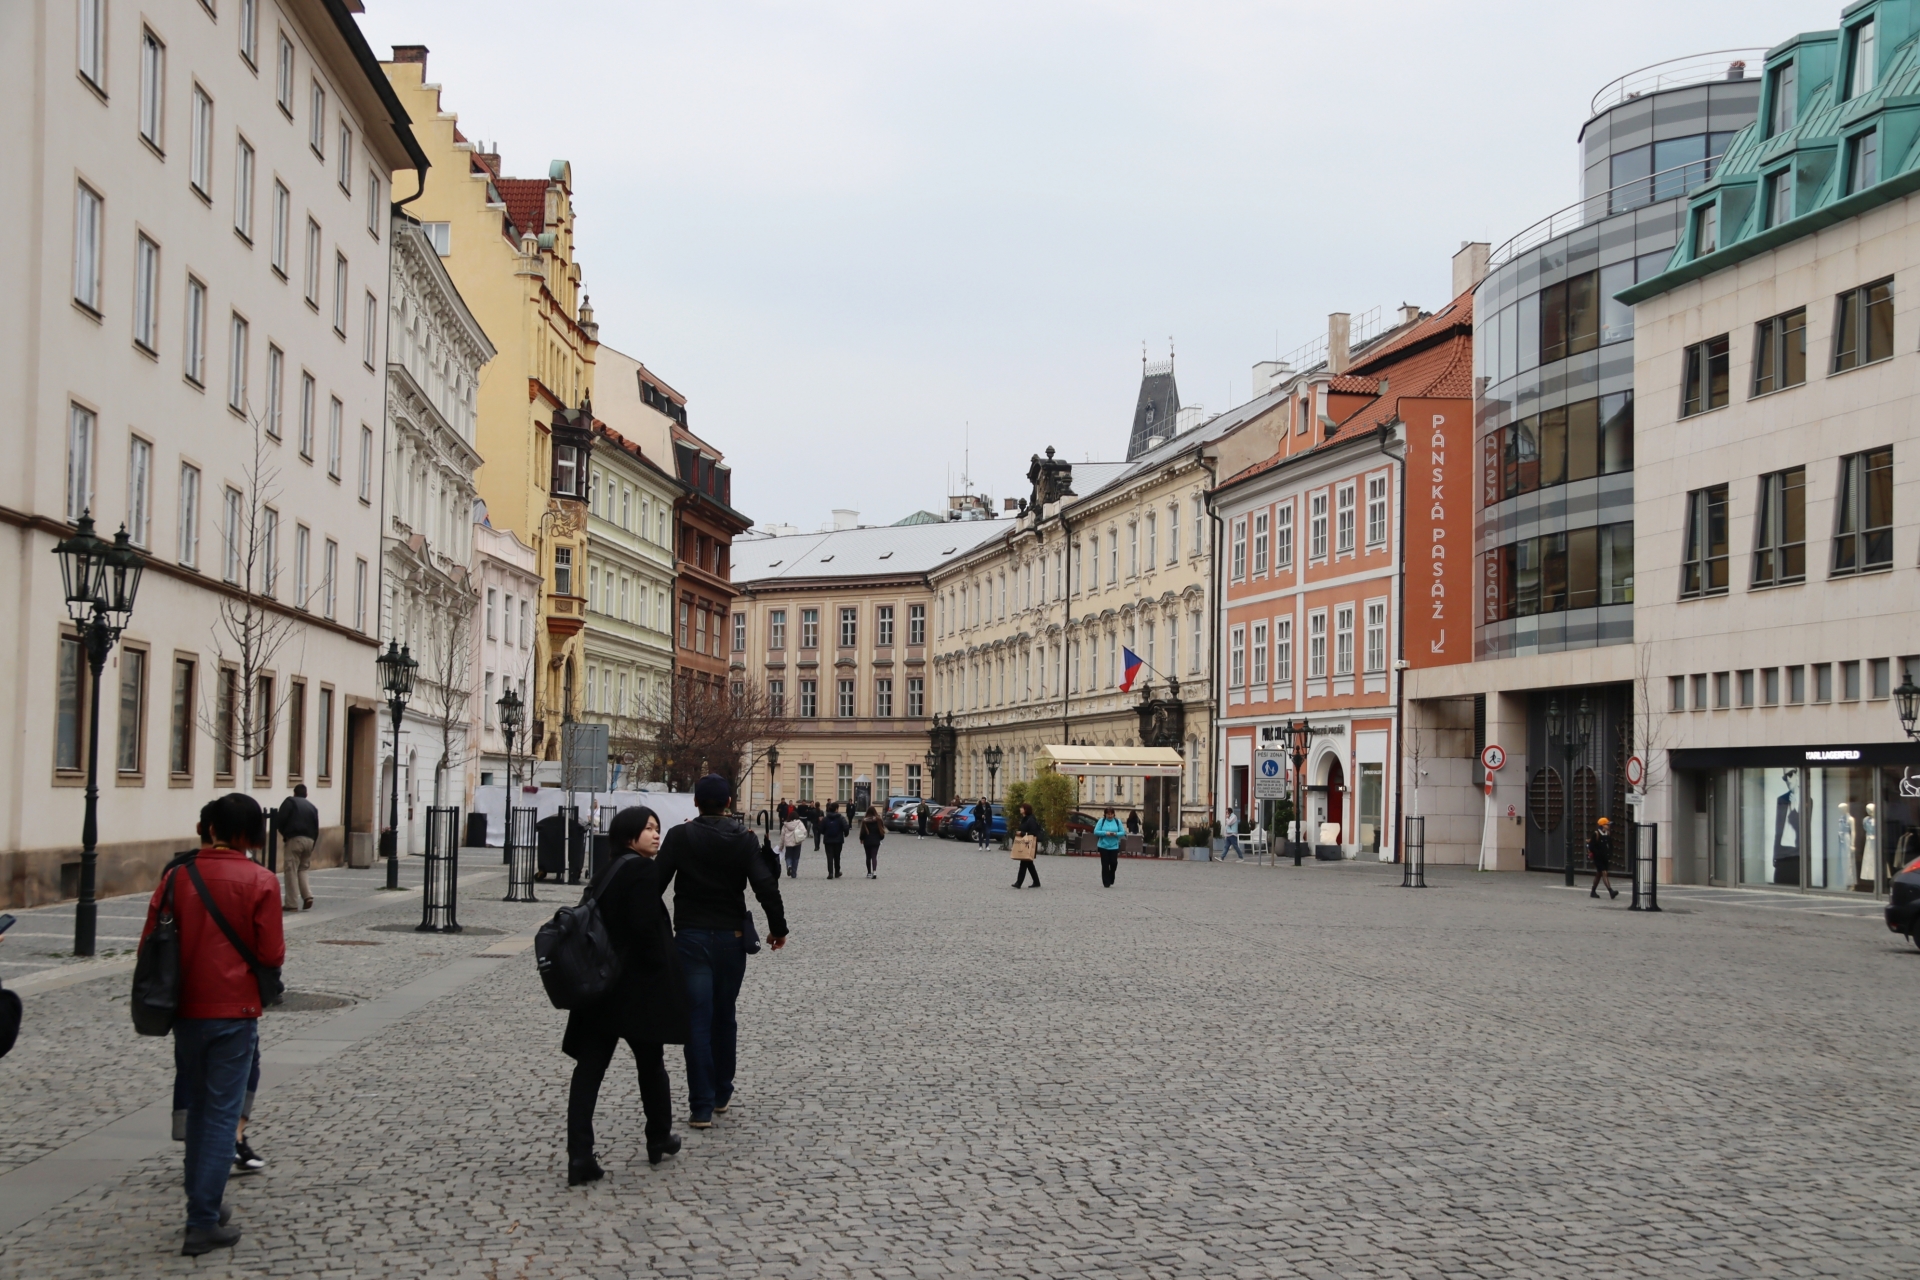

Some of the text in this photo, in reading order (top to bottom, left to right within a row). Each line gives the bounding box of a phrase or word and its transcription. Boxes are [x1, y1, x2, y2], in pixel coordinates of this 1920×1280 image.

[1431, 415, 1445, 619] PÁNSKÁ PASÁŽ
[1805, 750, 1861, 760] KARL LAGERFELD
